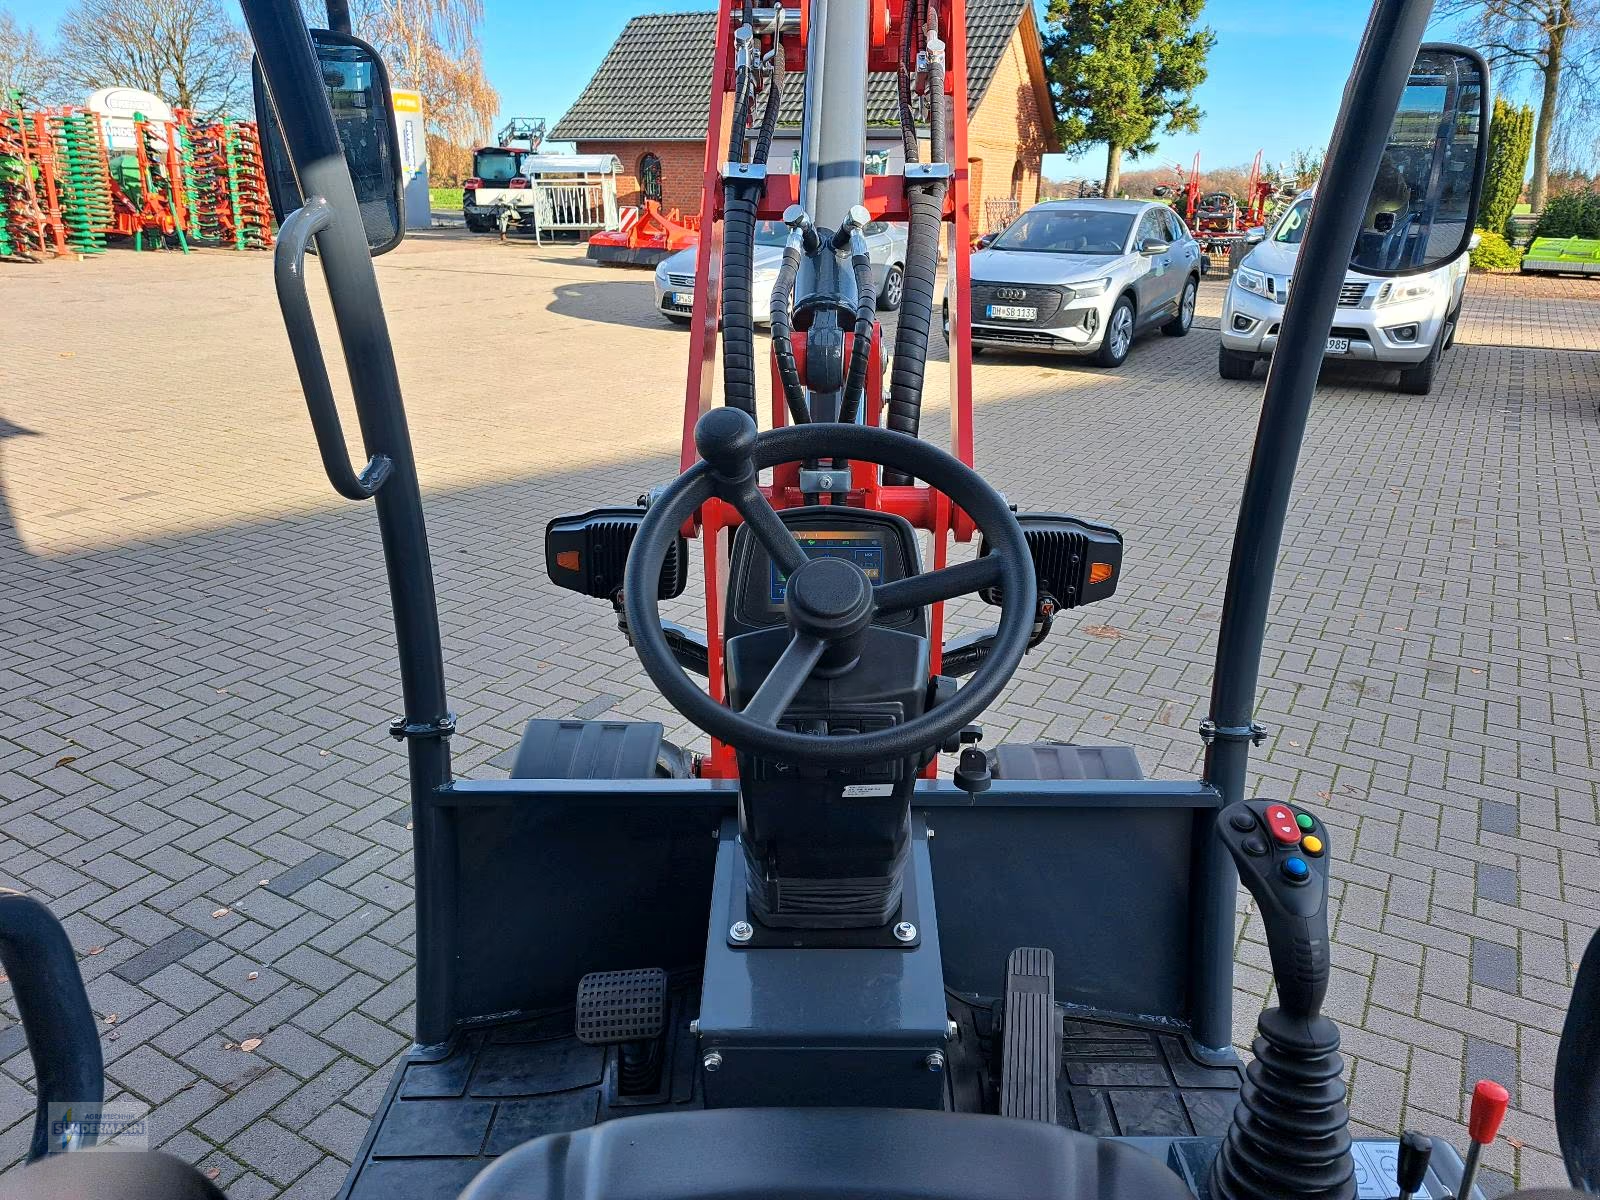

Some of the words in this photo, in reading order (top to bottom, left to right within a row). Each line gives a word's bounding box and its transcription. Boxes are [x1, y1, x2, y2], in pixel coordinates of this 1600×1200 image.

[992, 306, 1002, 316] DH
[1006, 307, 1016, 317] SB
[1017, 308, 1036, 318] 1133
